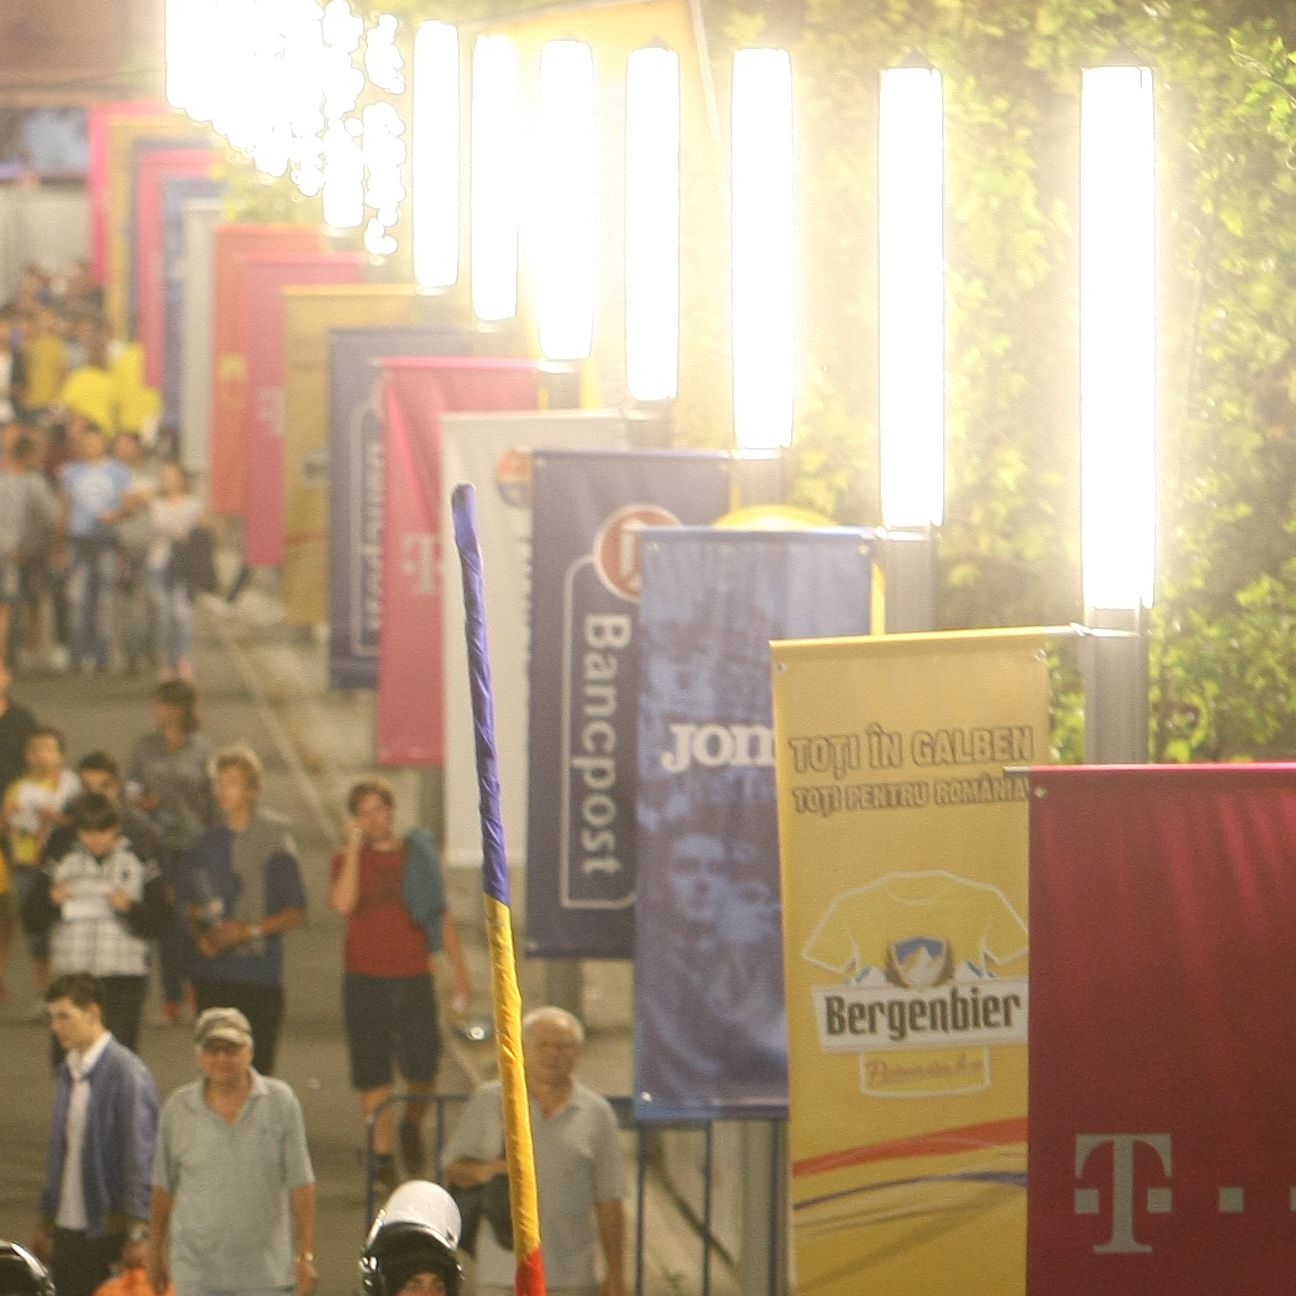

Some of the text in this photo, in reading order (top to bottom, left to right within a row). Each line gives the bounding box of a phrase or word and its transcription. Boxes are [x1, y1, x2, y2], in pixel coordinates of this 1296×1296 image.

[571, 614, 633, 876] Bancpost
[867, 723, 903, 769] ÎN
[911, 725, 1035, 767] GALBEN
[845, 781, 933, 811] PENTRU
[934, 772, 1030, 806] ROMÂNIA
[824, 986, 1021, 1041] Bergenbier
[1074, 1133, 1172, 1255] T
